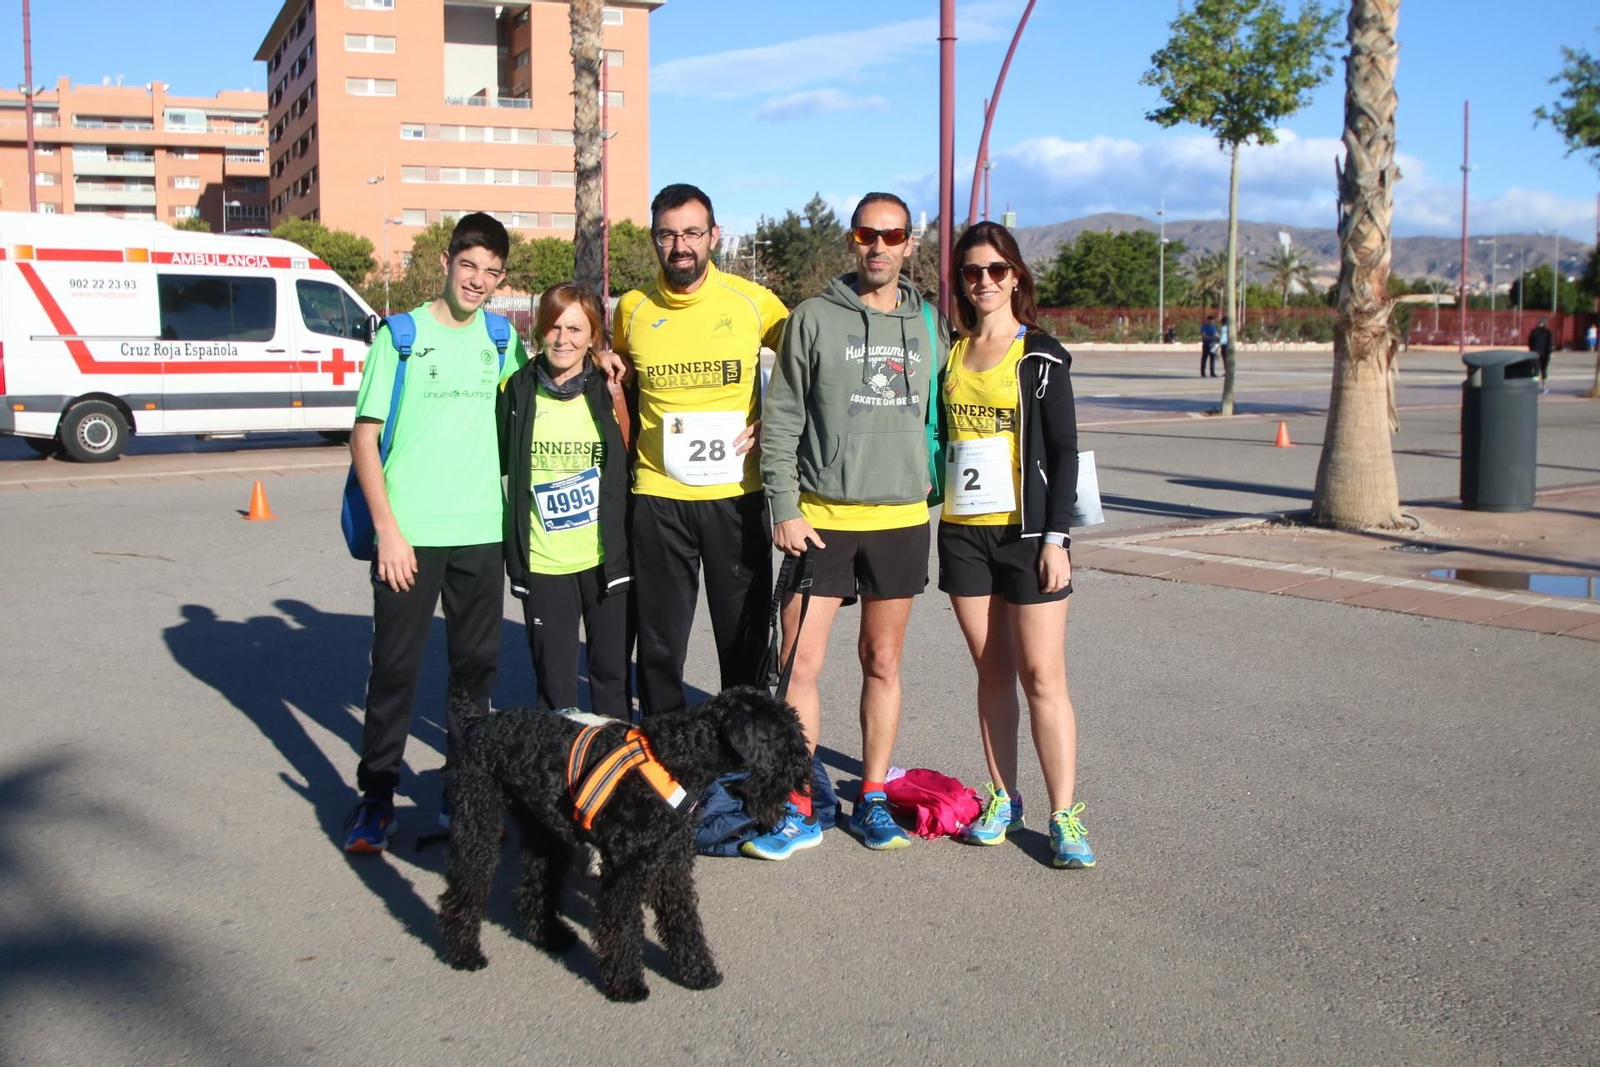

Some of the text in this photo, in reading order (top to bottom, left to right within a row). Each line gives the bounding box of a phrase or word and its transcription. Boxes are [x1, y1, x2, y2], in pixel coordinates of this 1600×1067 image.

[171, 252, 271, 268] AMBULANCIA
[69, 279, 137, 290] 902 22 23 93
[120, 342, 239, 360] Cruz Roja Española
[646, 360, 722, 378] RUNNERS
[726, 361, 738, 383] TEAM
[1000, 409, 1011, 430] TEAM
[531, 441, 591, 455] UNNERS
[688, 439, 726, 462] 28
[963, 468, 981, 491] 2
[547, 484, 595, 514] 4995
